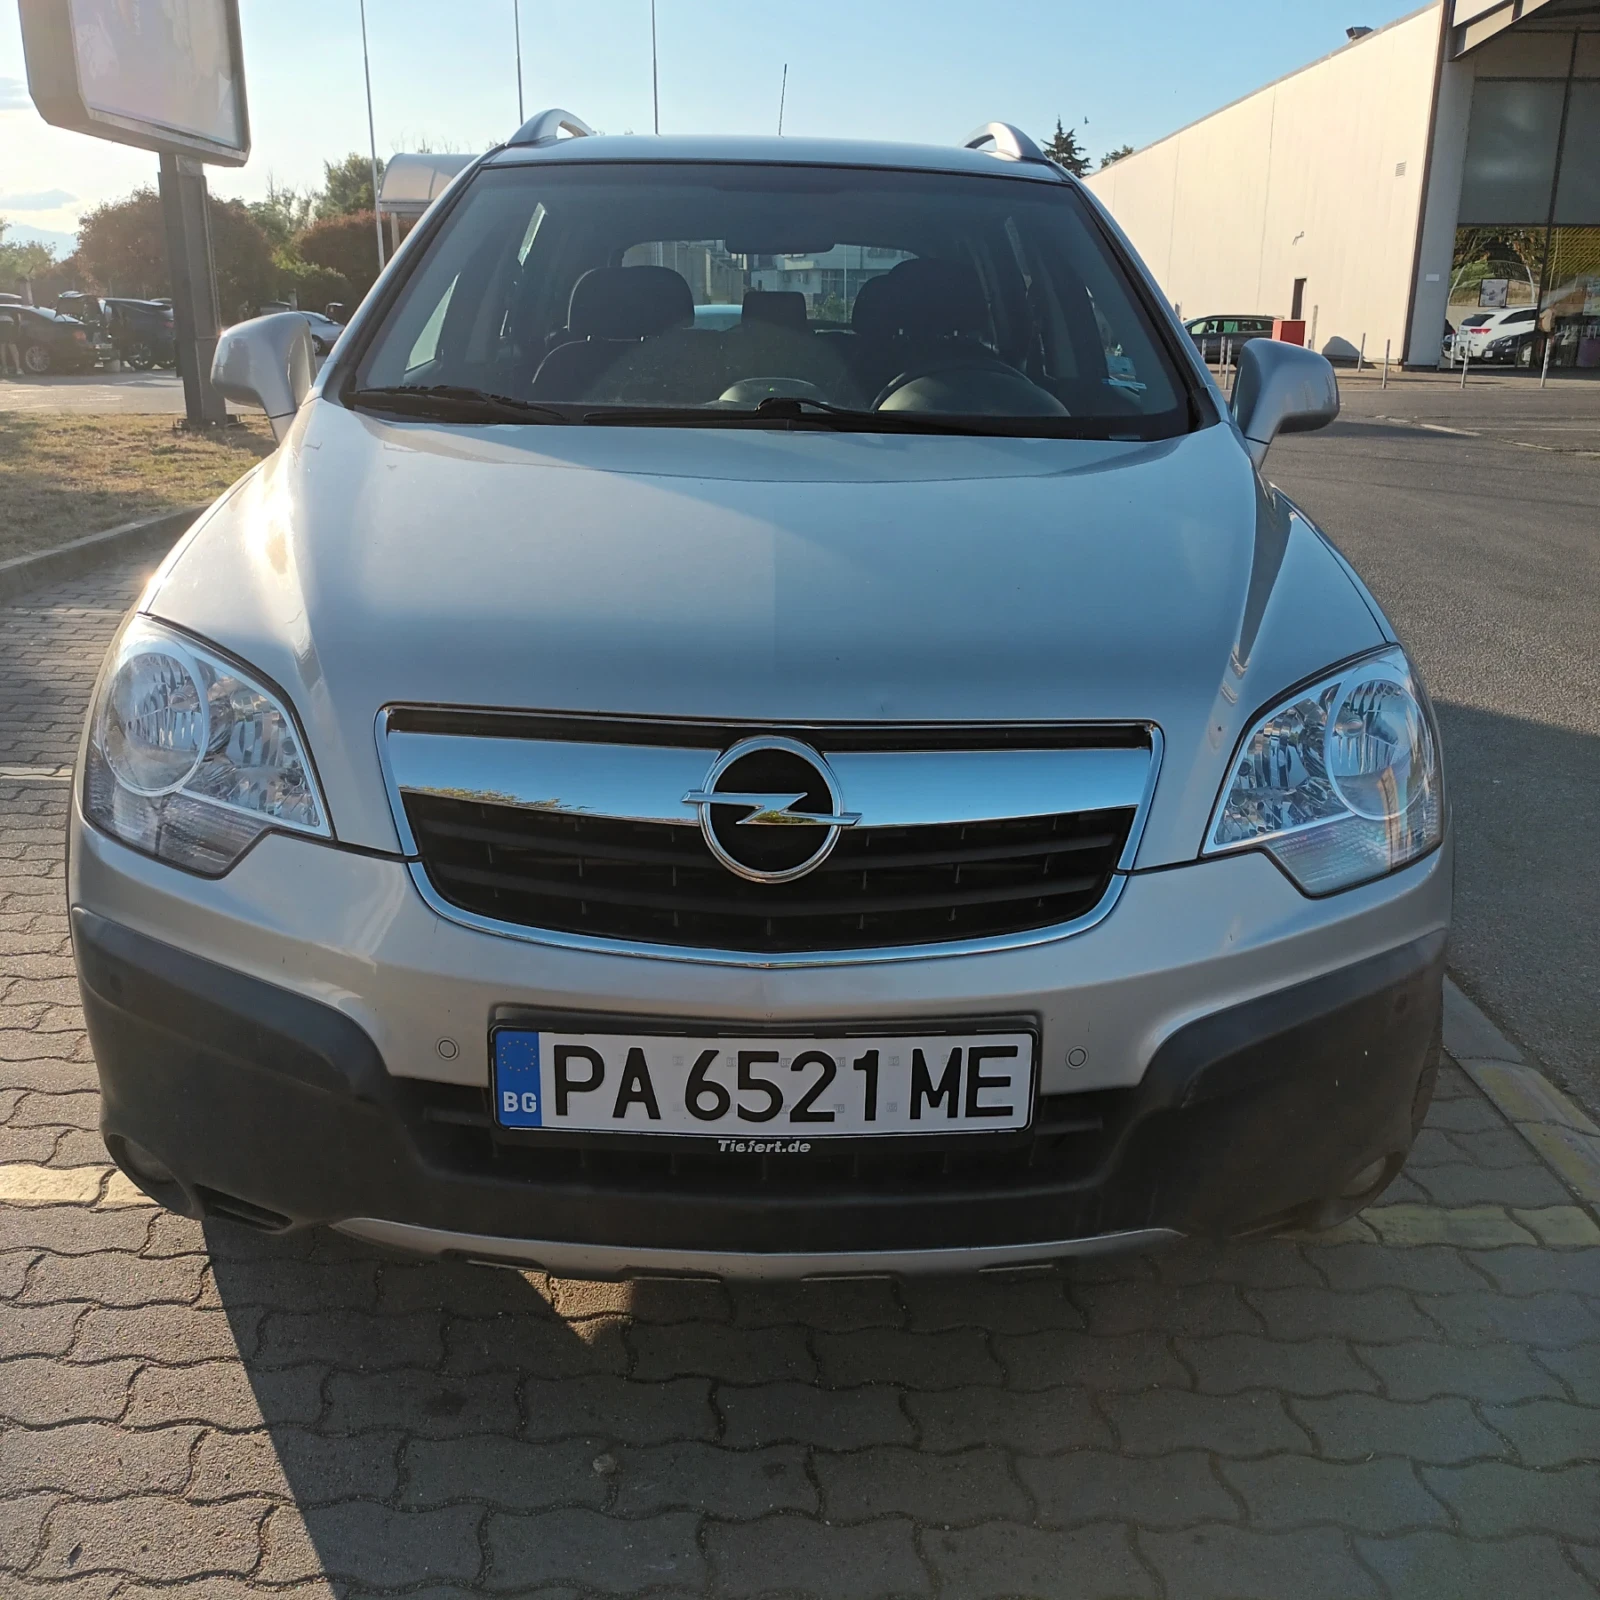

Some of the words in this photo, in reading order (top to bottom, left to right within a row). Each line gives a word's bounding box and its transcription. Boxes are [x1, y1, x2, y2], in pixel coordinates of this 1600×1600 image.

[554, 1045, 661, 1120] PA
[685, 1049, 879, 1123] 6521
[910, 1046, 1018, 1120] ME
[503, 1091, 537, 1113] BG
[718, 1139, 811, 1153] Tiefert.de
